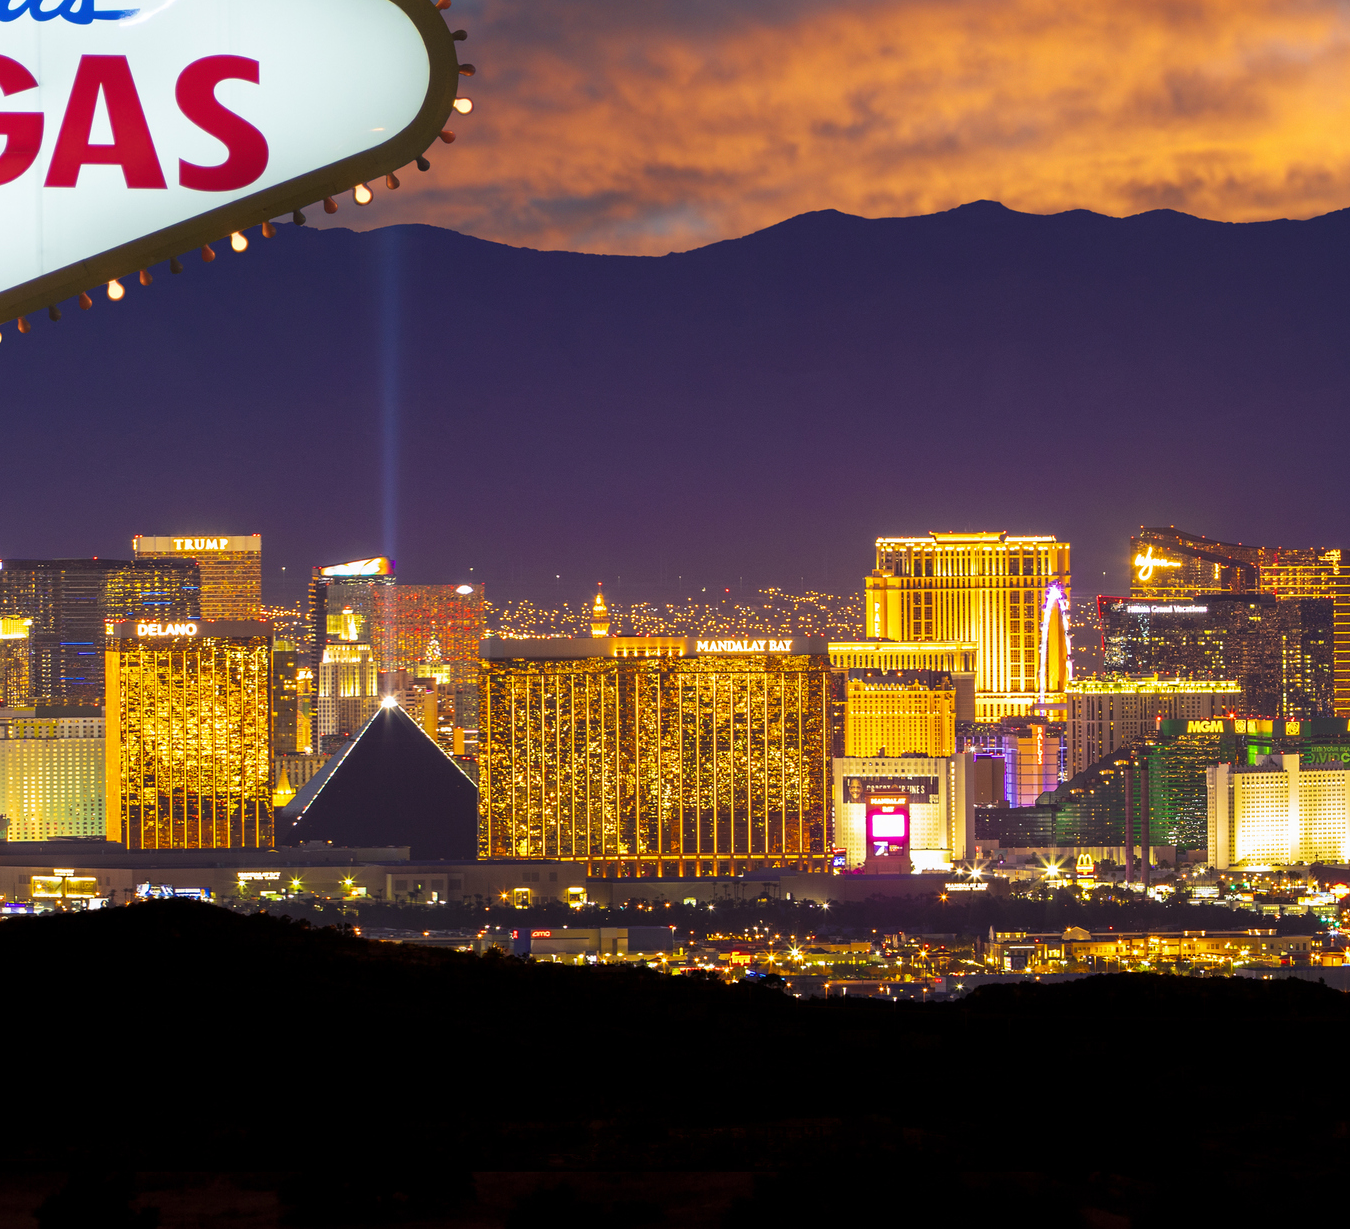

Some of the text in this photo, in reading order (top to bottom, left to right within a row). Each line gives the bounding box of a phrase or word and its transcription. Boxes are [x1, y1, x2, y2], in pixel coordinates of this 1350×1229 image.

[173, 538, 229, 550] TRUMP
[137, 623, 198, 636] DELANO
[696, 640, 793, 652] MANDALAY BAY
[1187, 720, 1225, 733] MGM
